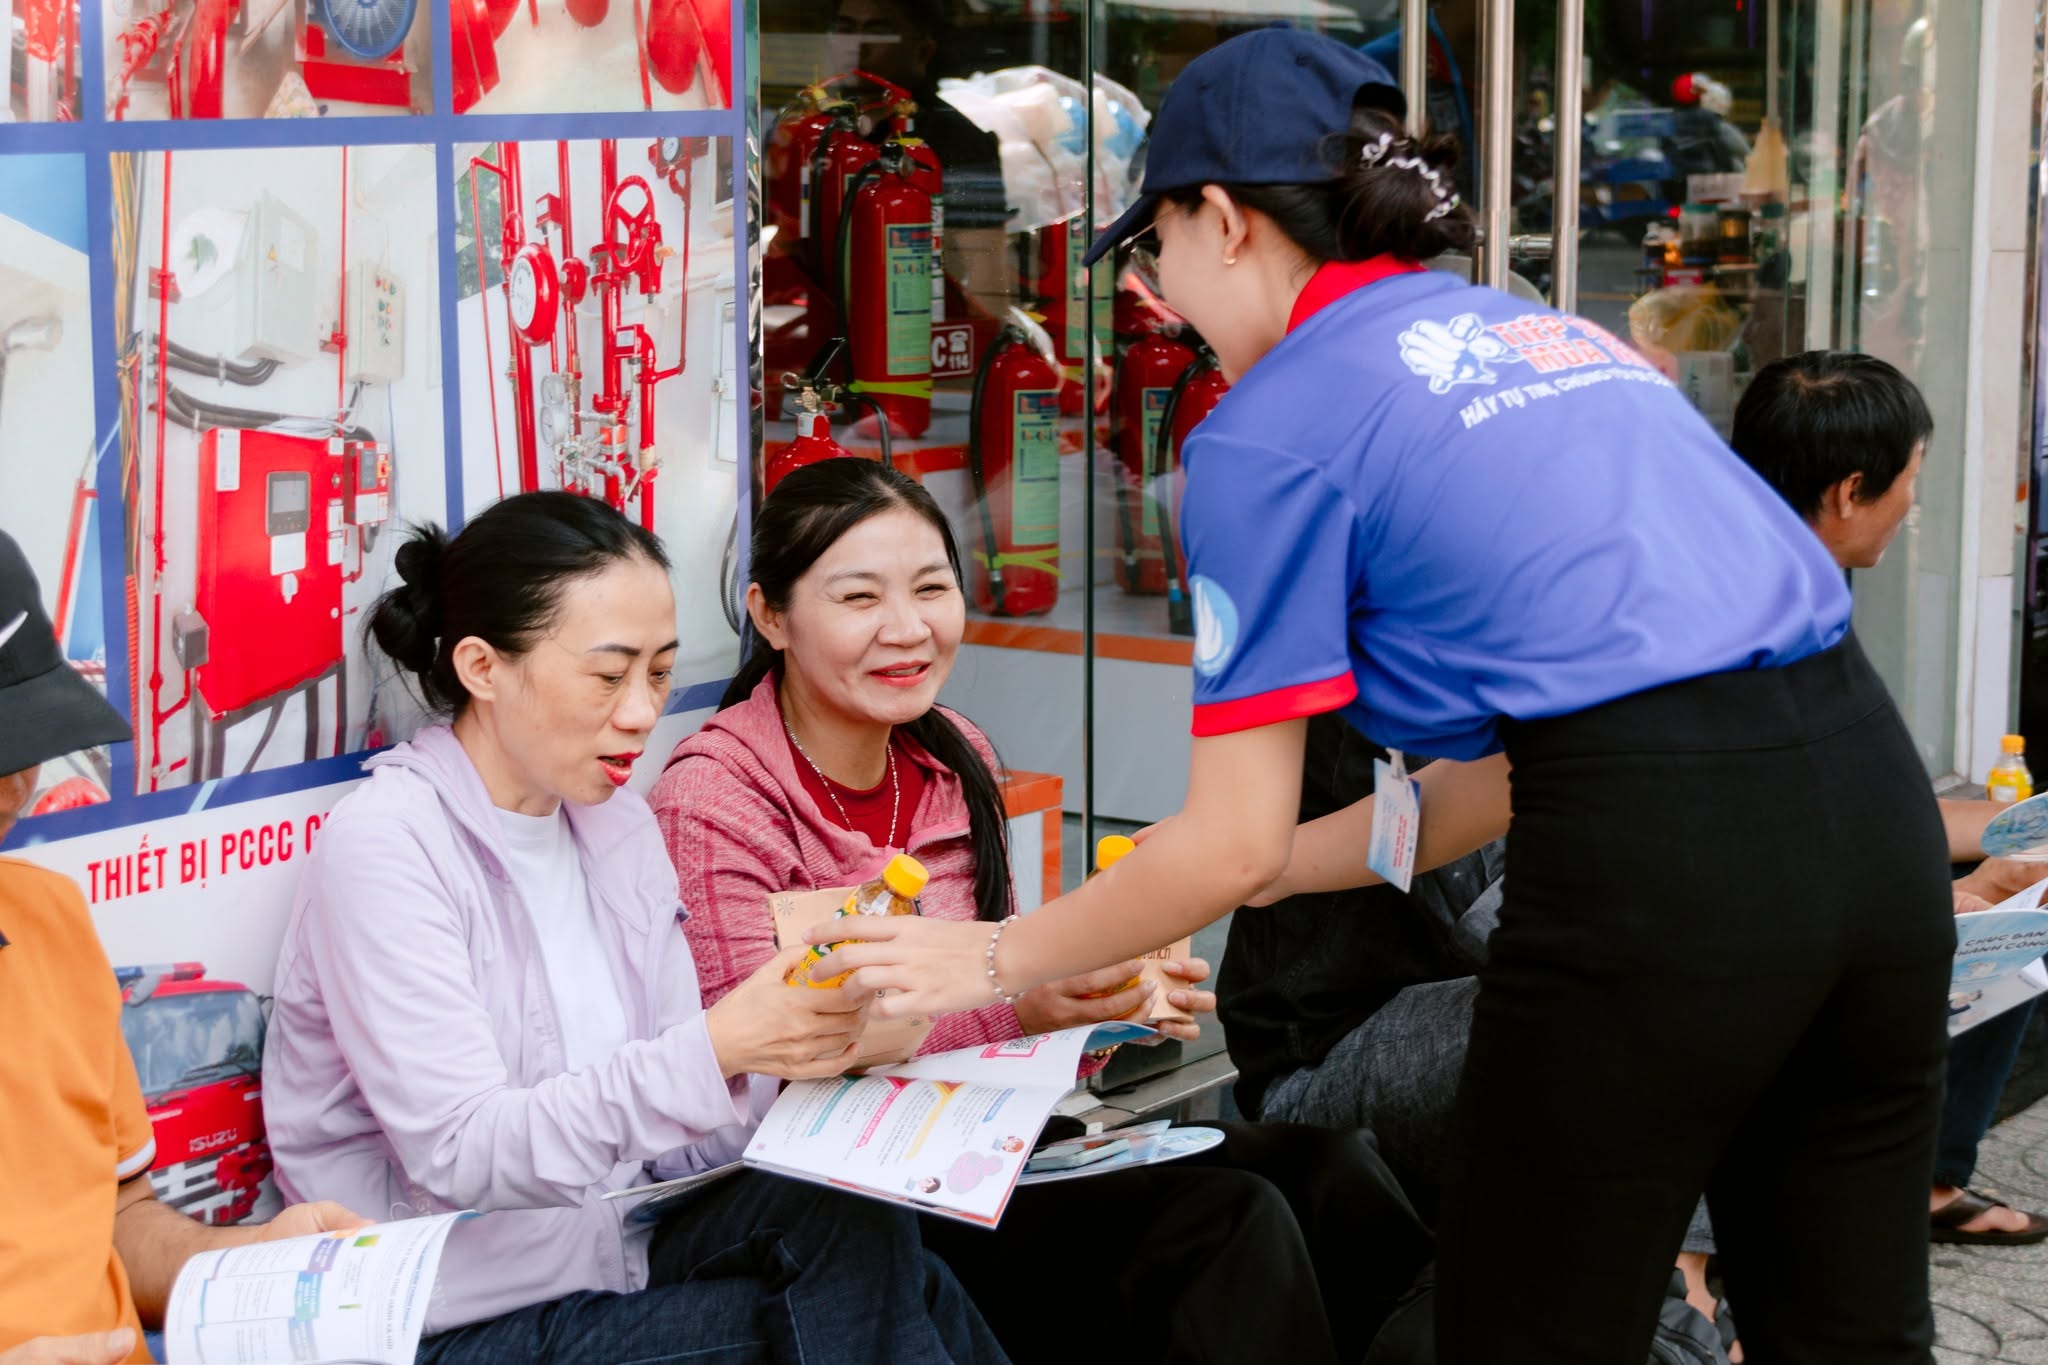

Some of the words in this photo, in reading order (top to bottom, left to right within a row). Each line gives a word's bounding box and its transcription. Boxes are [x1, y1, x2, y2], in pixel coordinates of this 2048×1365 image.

[87, 834, 169, 905] THIẾT
[180, 838, 208, 889] BỊ
[220, 820, 294, 875] PCCC
[188, 1128, 238, 1153] ISUZU
